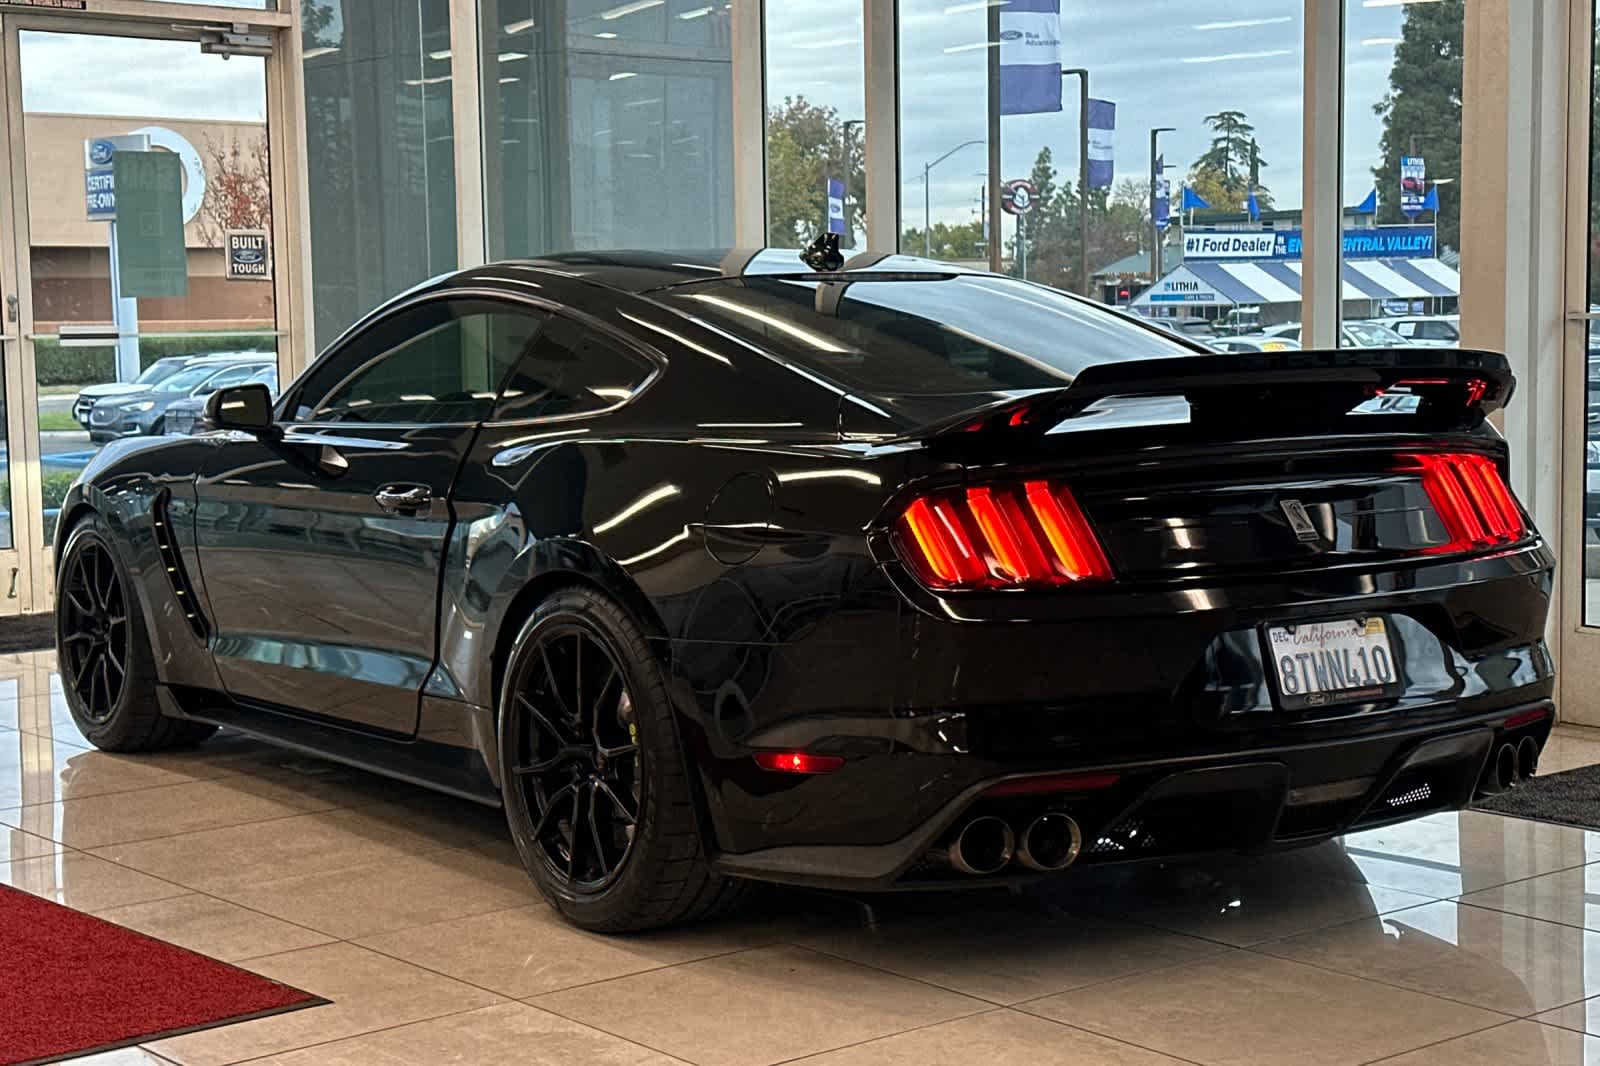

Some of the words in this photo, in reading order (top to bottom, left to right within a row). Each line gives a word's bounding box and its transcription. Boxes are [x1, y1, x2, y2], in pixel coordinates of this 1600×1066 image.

[231, 236, 264, 249] BUILT
[1186, 239, 1201, 252] #1
[1202, 238, 1231, 252] Ford
[1232, 237, 1271, 251] Dealer
[232, 263, 265, 273] TOUGH
[1171, 281, 1199, 292] LITHIA
[1272, 630, 1290, 643] DEC
[1293, 624, 1365, 649] California
[1280, 644, 1392, 694] 8TWN410
